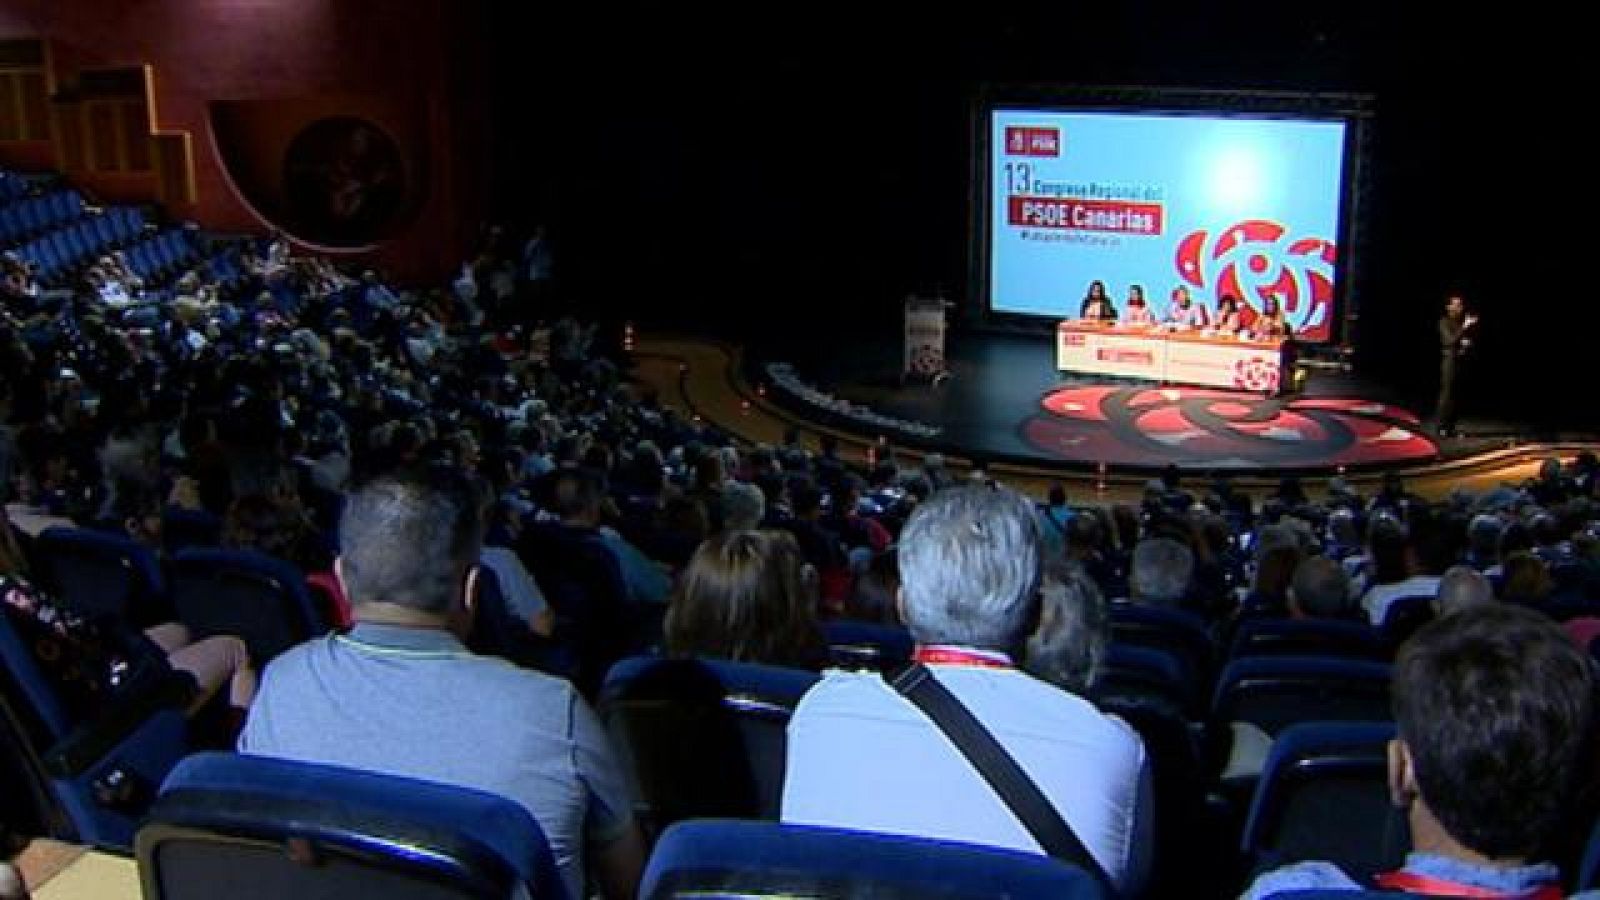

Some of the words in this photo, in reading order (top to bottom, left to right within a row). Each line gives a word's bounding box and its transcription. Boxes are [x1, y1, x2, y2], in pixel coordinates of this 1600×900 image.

[1034, 179, 1086, 199] Congreso
[1089, 182, 1140, 201] Regional
[1022, 201, 1068, 226] PSOE
[1073, 205, 1154, 231] Canarias
